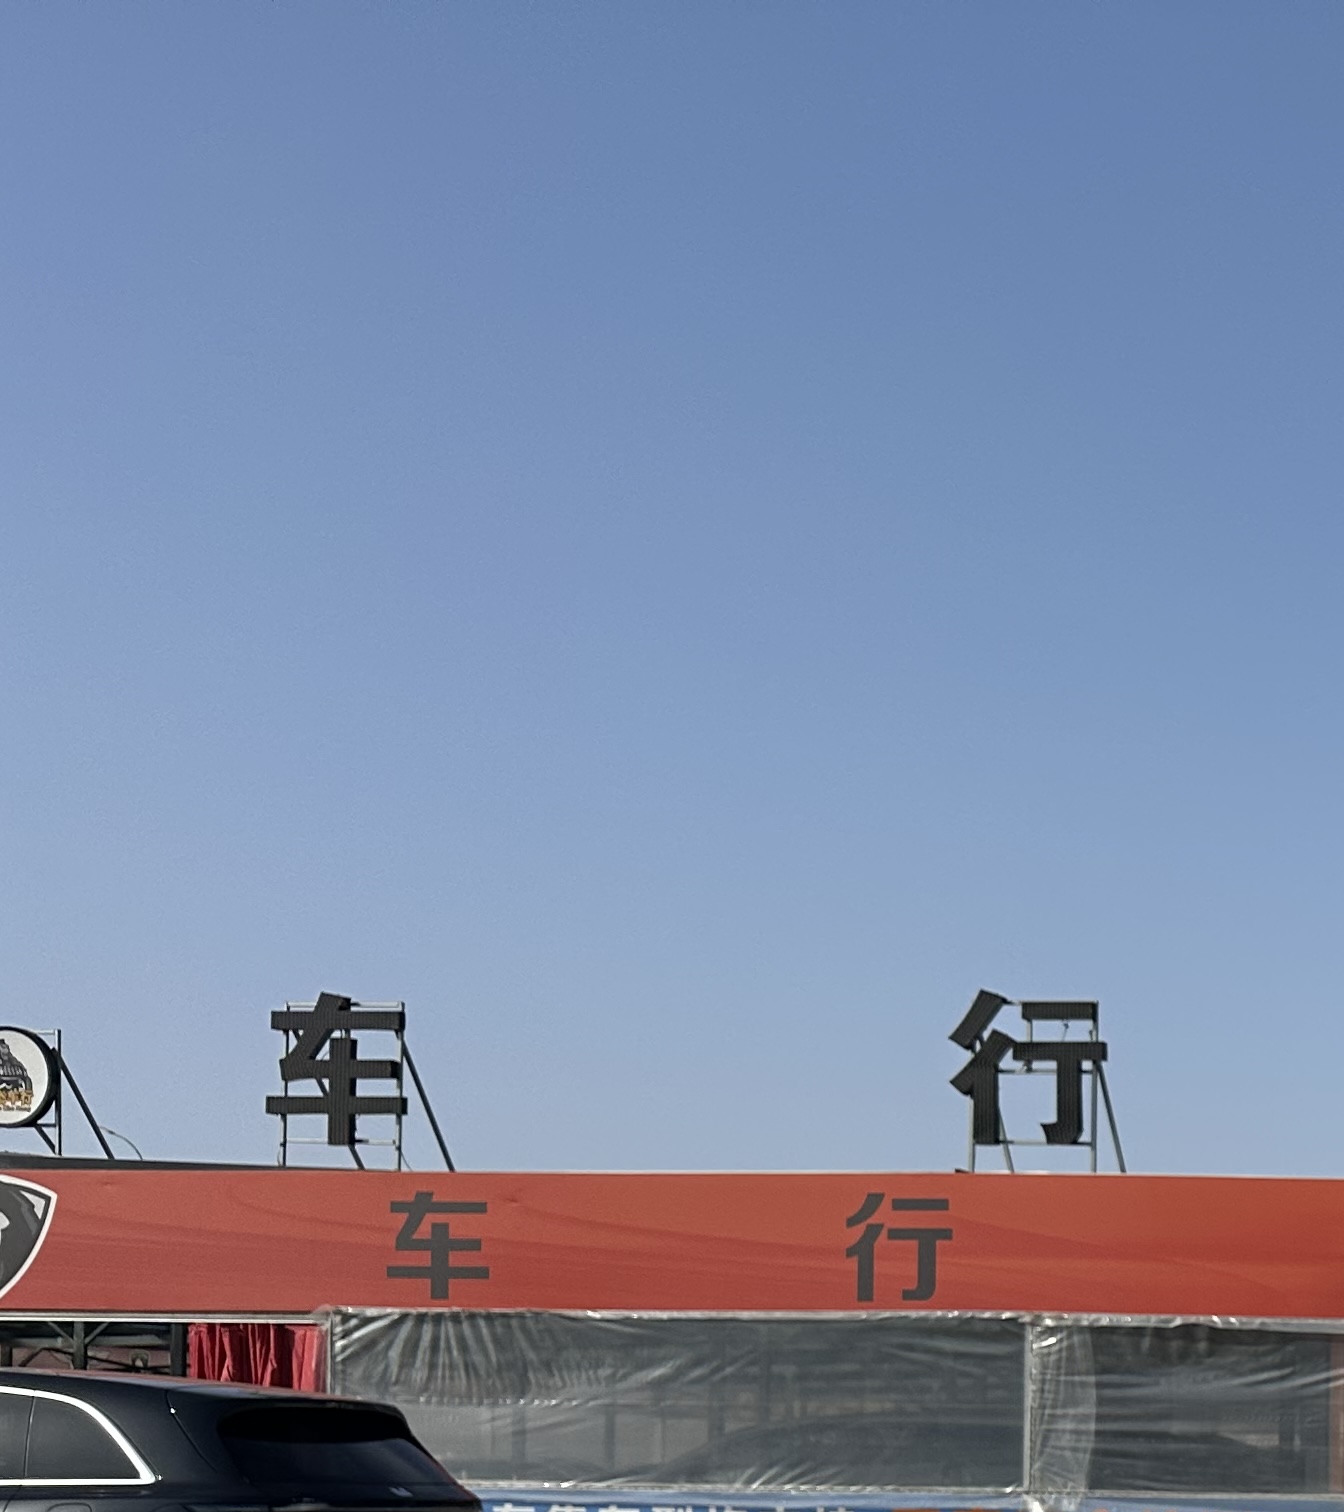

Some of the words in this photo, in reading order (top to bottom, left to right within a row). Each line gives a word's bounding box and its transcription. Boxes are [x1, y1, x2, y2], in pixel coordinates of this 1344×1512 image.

[266, 992, 408, 1146] 车
[949, 989, 1107, 1146] 行
[387, 1192, 489, 1299] 车
[845, 1192, 953, 1302] 行
